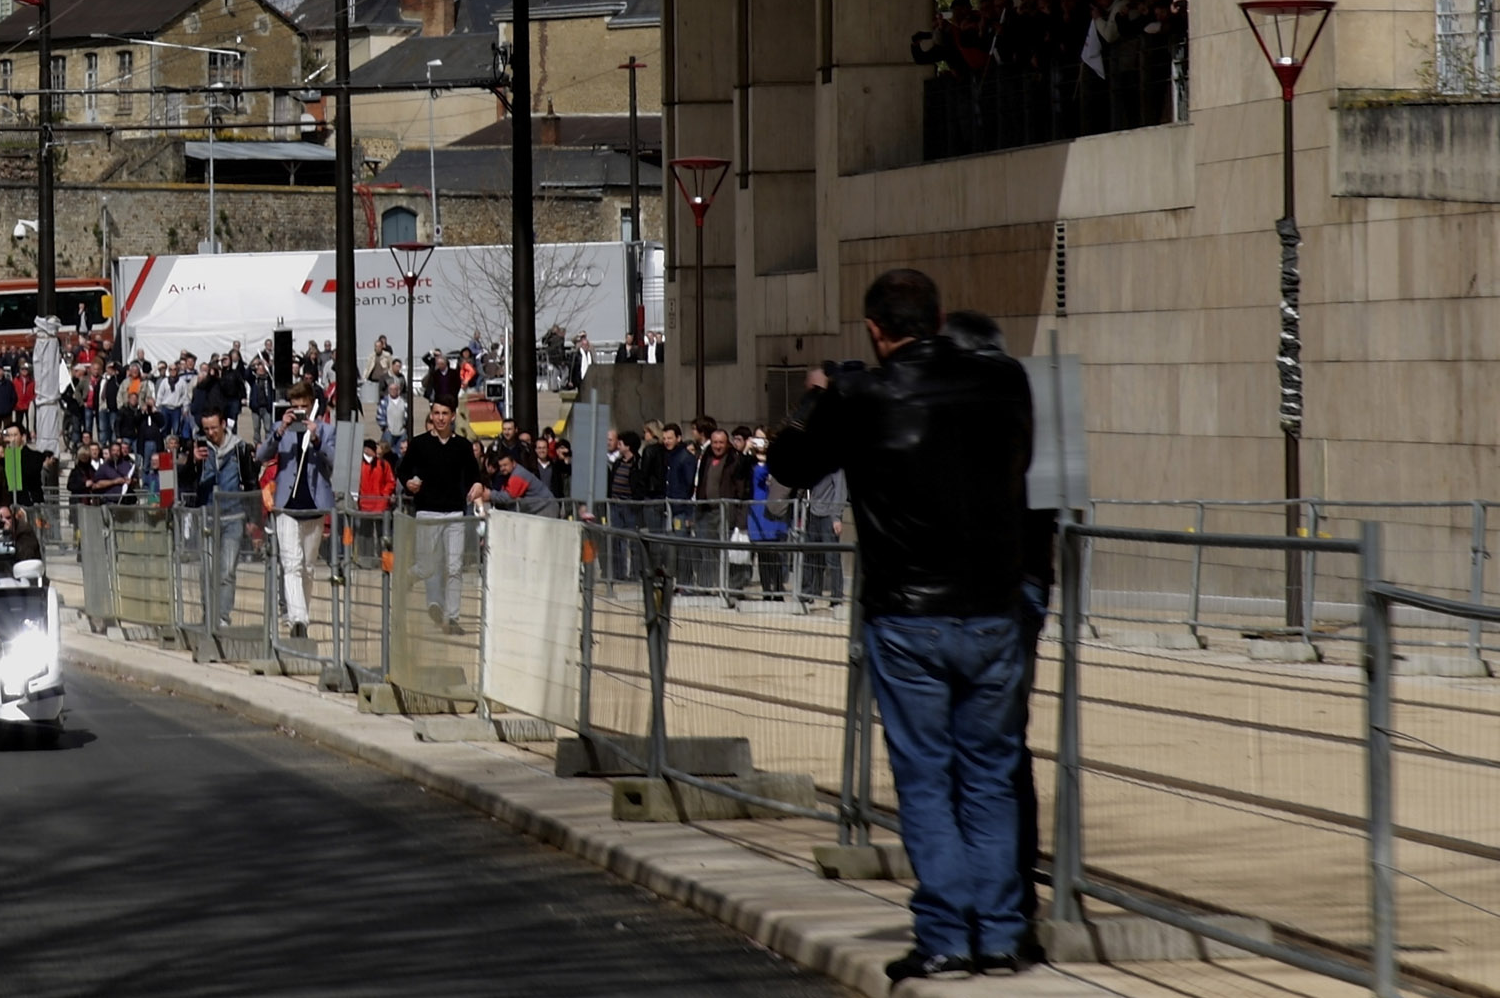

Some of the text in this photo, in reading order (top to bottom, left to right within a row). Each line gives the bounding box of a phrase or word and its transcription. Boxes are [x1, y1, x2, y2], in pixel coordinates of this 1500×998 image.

[355, 276, 432, 290] udi Sprt
[355, 295, 387, 306] eam
